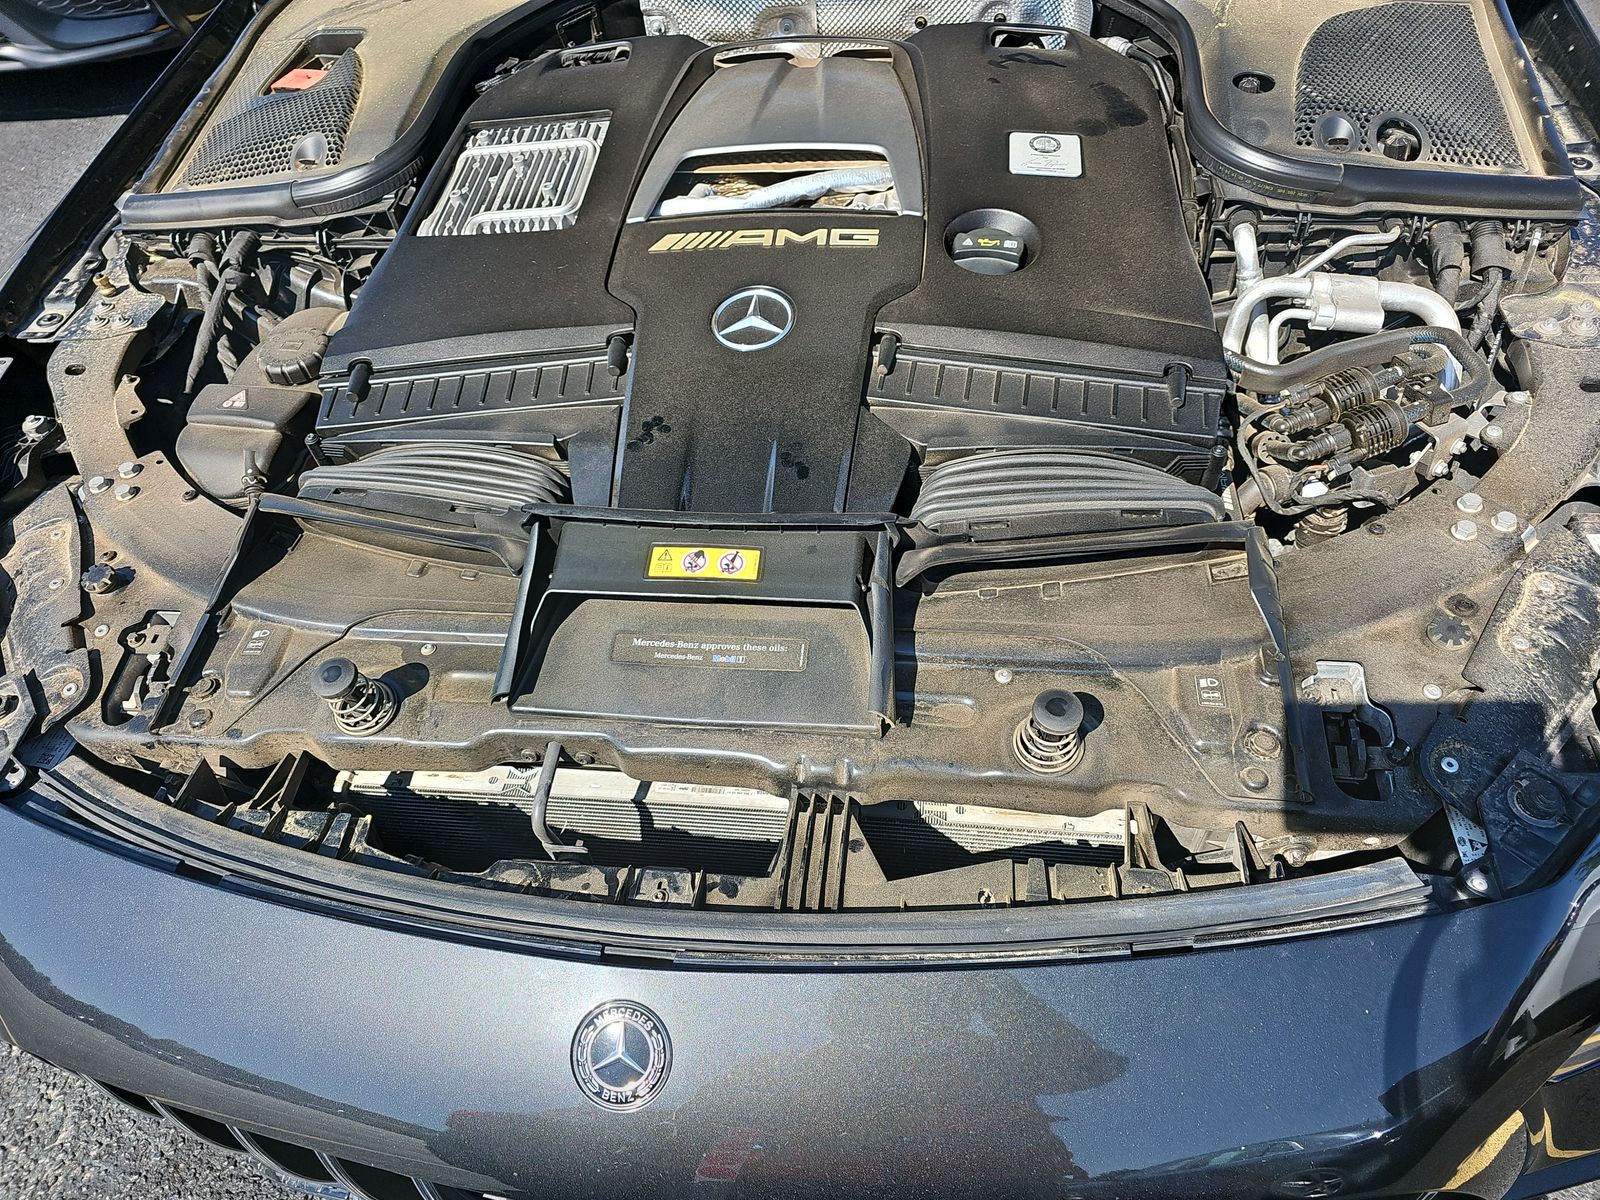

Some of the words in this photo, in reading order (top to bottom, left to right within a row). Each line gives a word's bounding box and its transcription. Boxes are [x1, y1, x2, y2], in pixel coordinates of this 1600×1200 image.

[718, 228, 880, 247] AMG
[632, 638, 699, 649] Mercedes-Benz
[701, 642, 741, 651] approves
[743, 643, 767, 652] these
[769, 644, 788, 652] oils:
[654, 652, 703, 661] Mercedes-Benz
[593, 1007, 654, 1031] MERCEDES
[601, 1089, 635, 1103] BENZ
